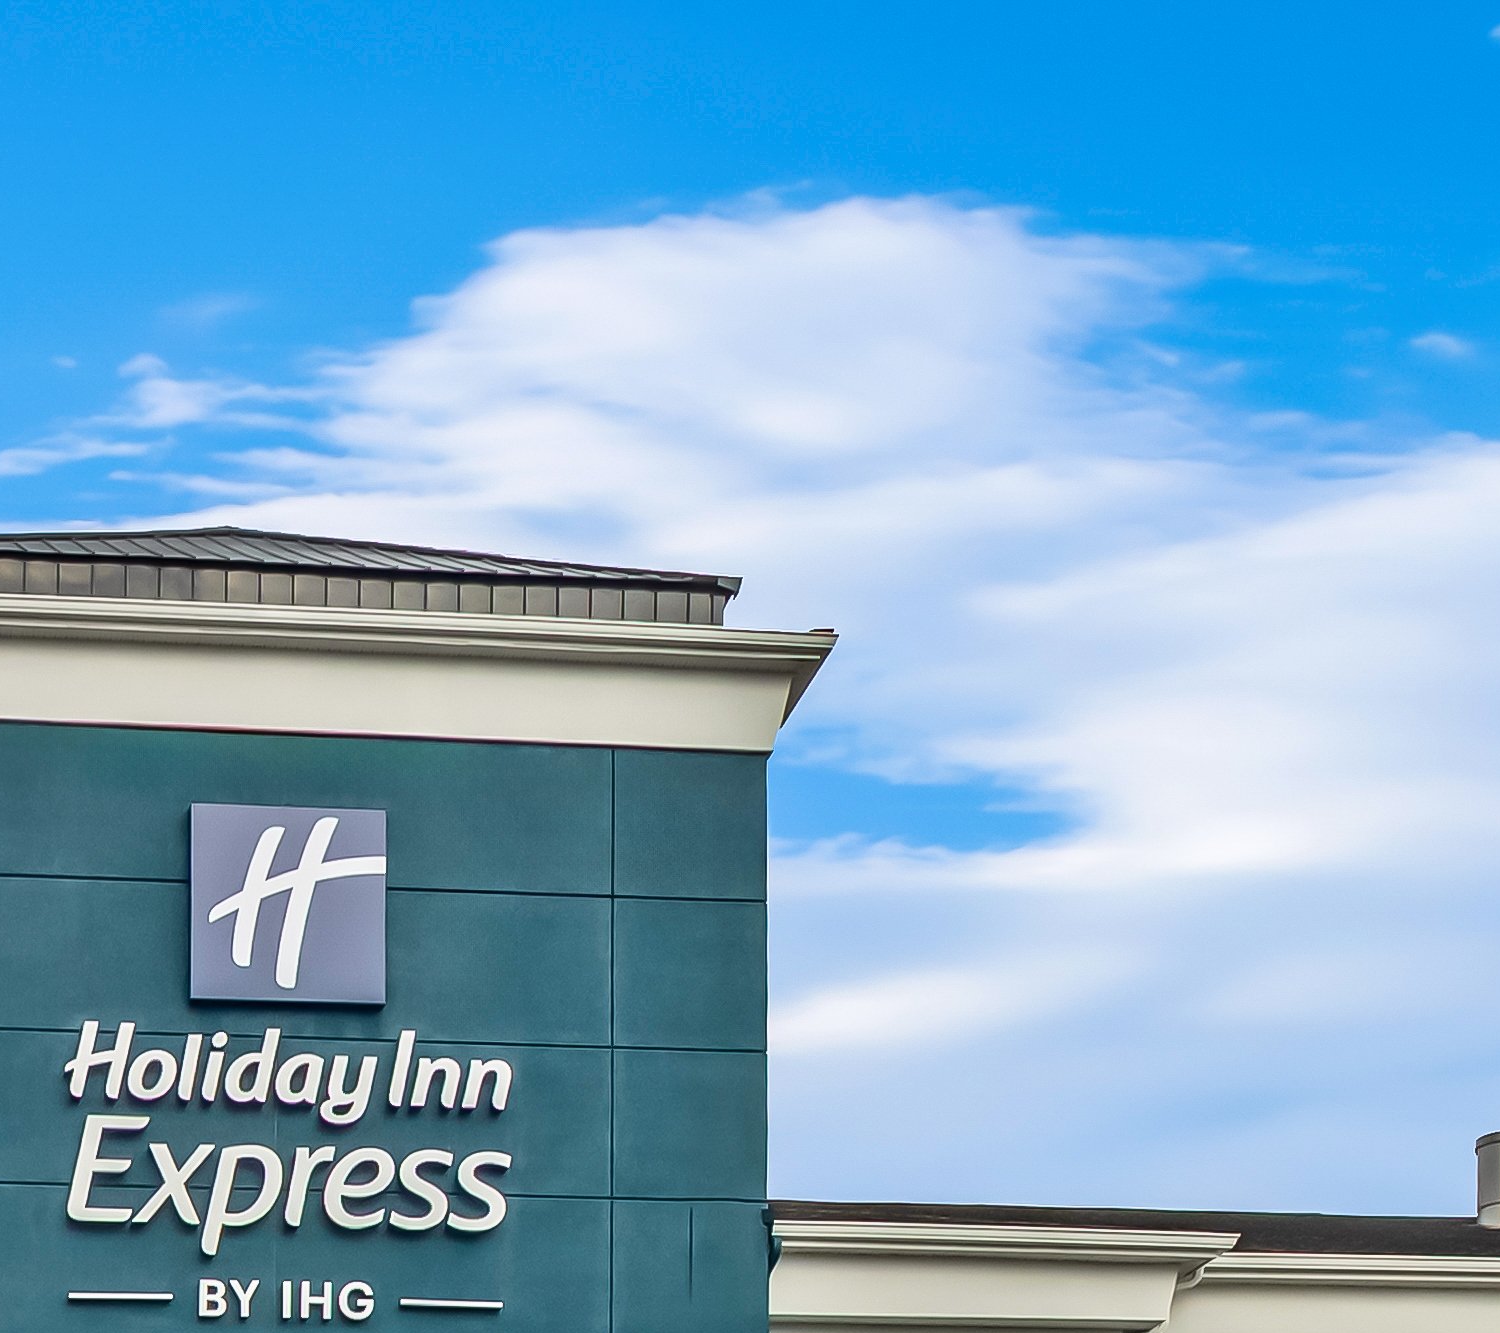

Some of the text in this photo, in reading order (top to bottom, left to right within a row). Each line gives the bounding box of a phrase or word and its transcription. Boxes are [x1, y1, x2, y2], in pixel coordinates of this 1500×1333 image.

[207, 815, 387, 990] H
[64, 1019, 514, 1127] Holiday Inn
[66, 1113, 513, 1257] Express
[197, 1277, 376, 1322] BY IHG
